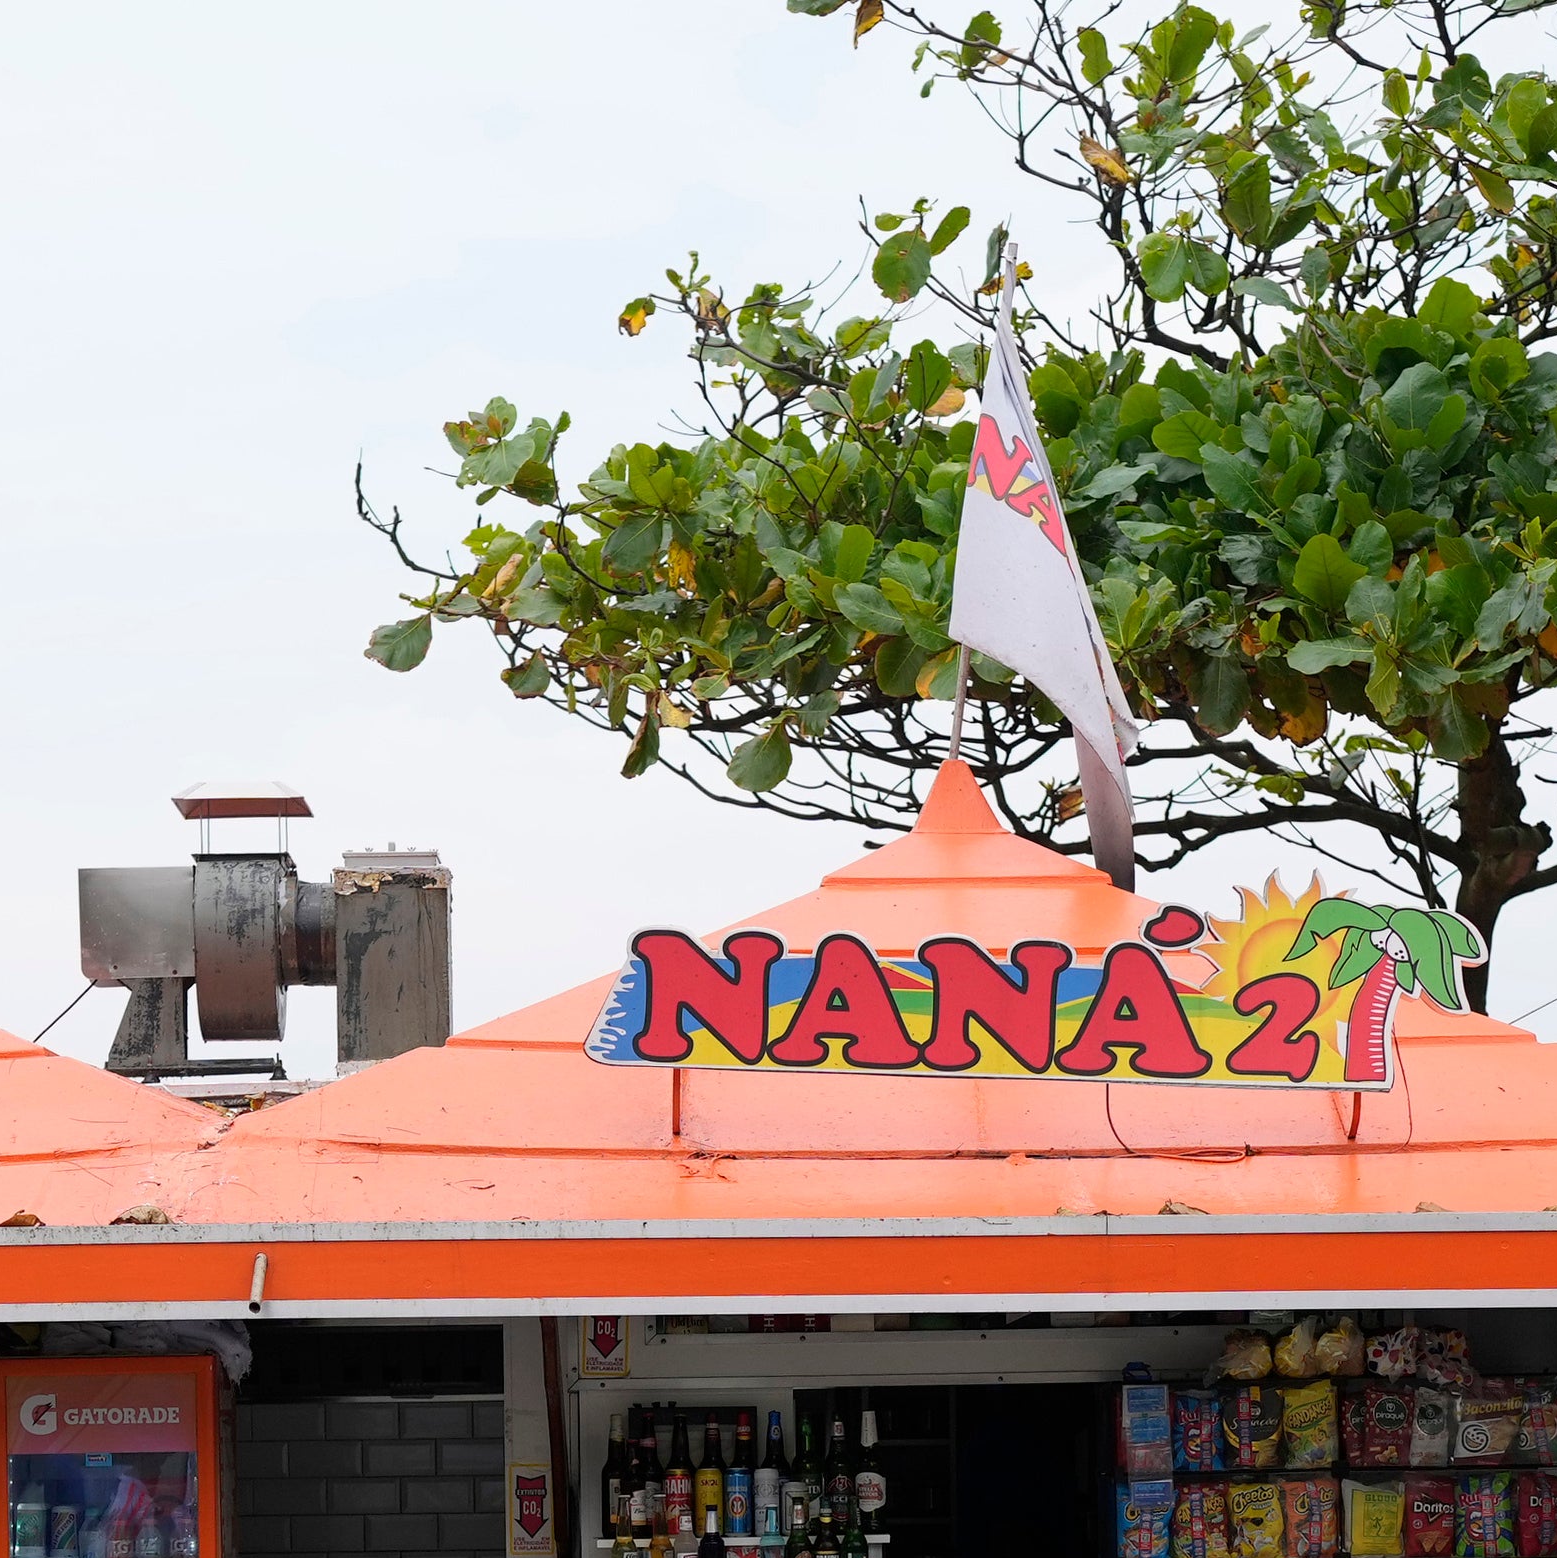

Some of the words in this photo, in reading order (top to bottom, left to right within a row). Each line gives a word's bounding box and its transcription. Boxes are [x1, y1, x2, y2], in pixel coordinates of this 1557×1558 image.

[632, 904, 1214, 1078] NANÁ
[1226, 973, 1323, 1083] 2
[19, 1393, 58, 1436] G
[64, 1406, 181, 1425] GATORADE
[1231, 1486, 1275, 1514] Cheetos
[1413, 1500, 1455, 1514] Doritos
